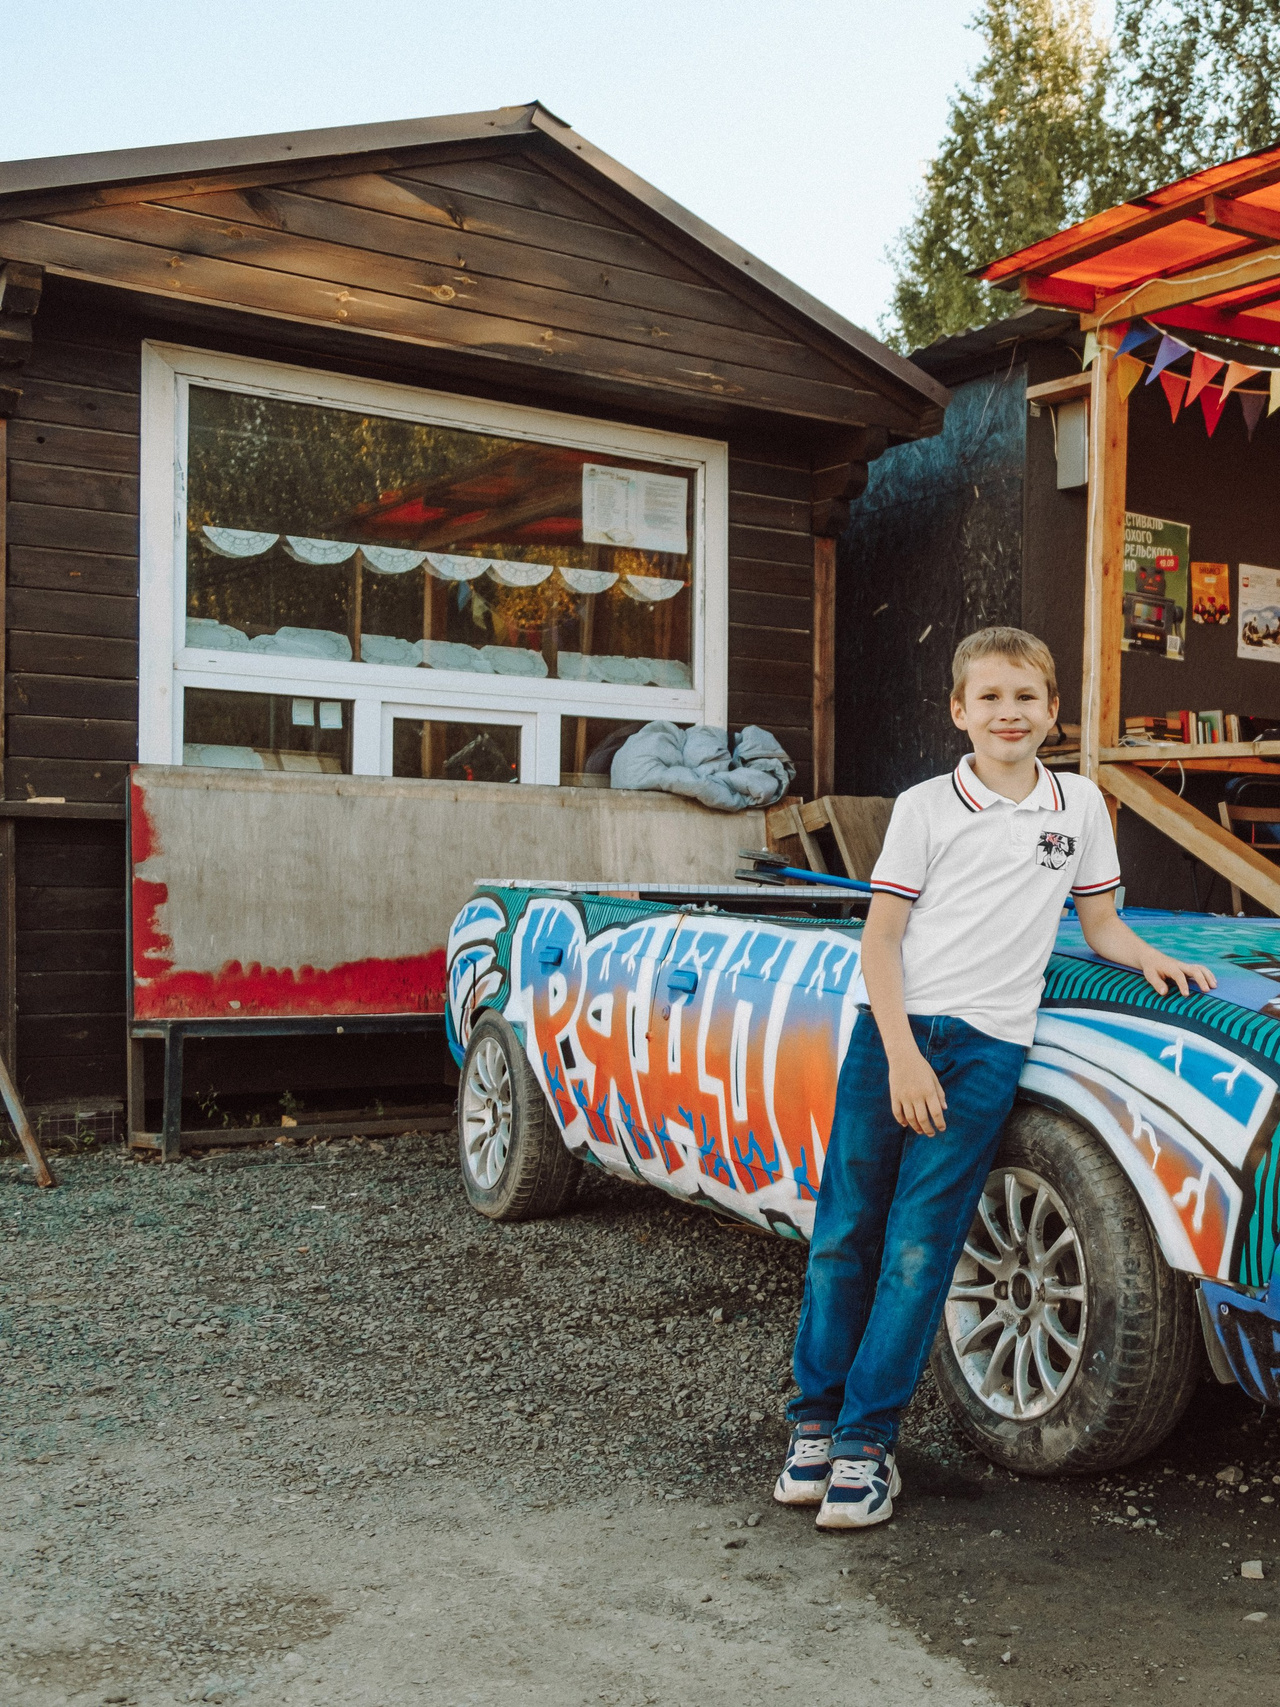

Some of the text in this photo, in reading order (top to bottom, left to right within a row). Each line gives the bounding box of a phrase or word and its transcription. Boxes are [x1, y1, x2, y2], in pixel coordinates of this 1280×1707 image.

[1125, 513, 1164, 531] СТИВАЛЬ
[1124, 528, 1153, 544] ОХОГО
[1124, 558, 1137, 572] НО
